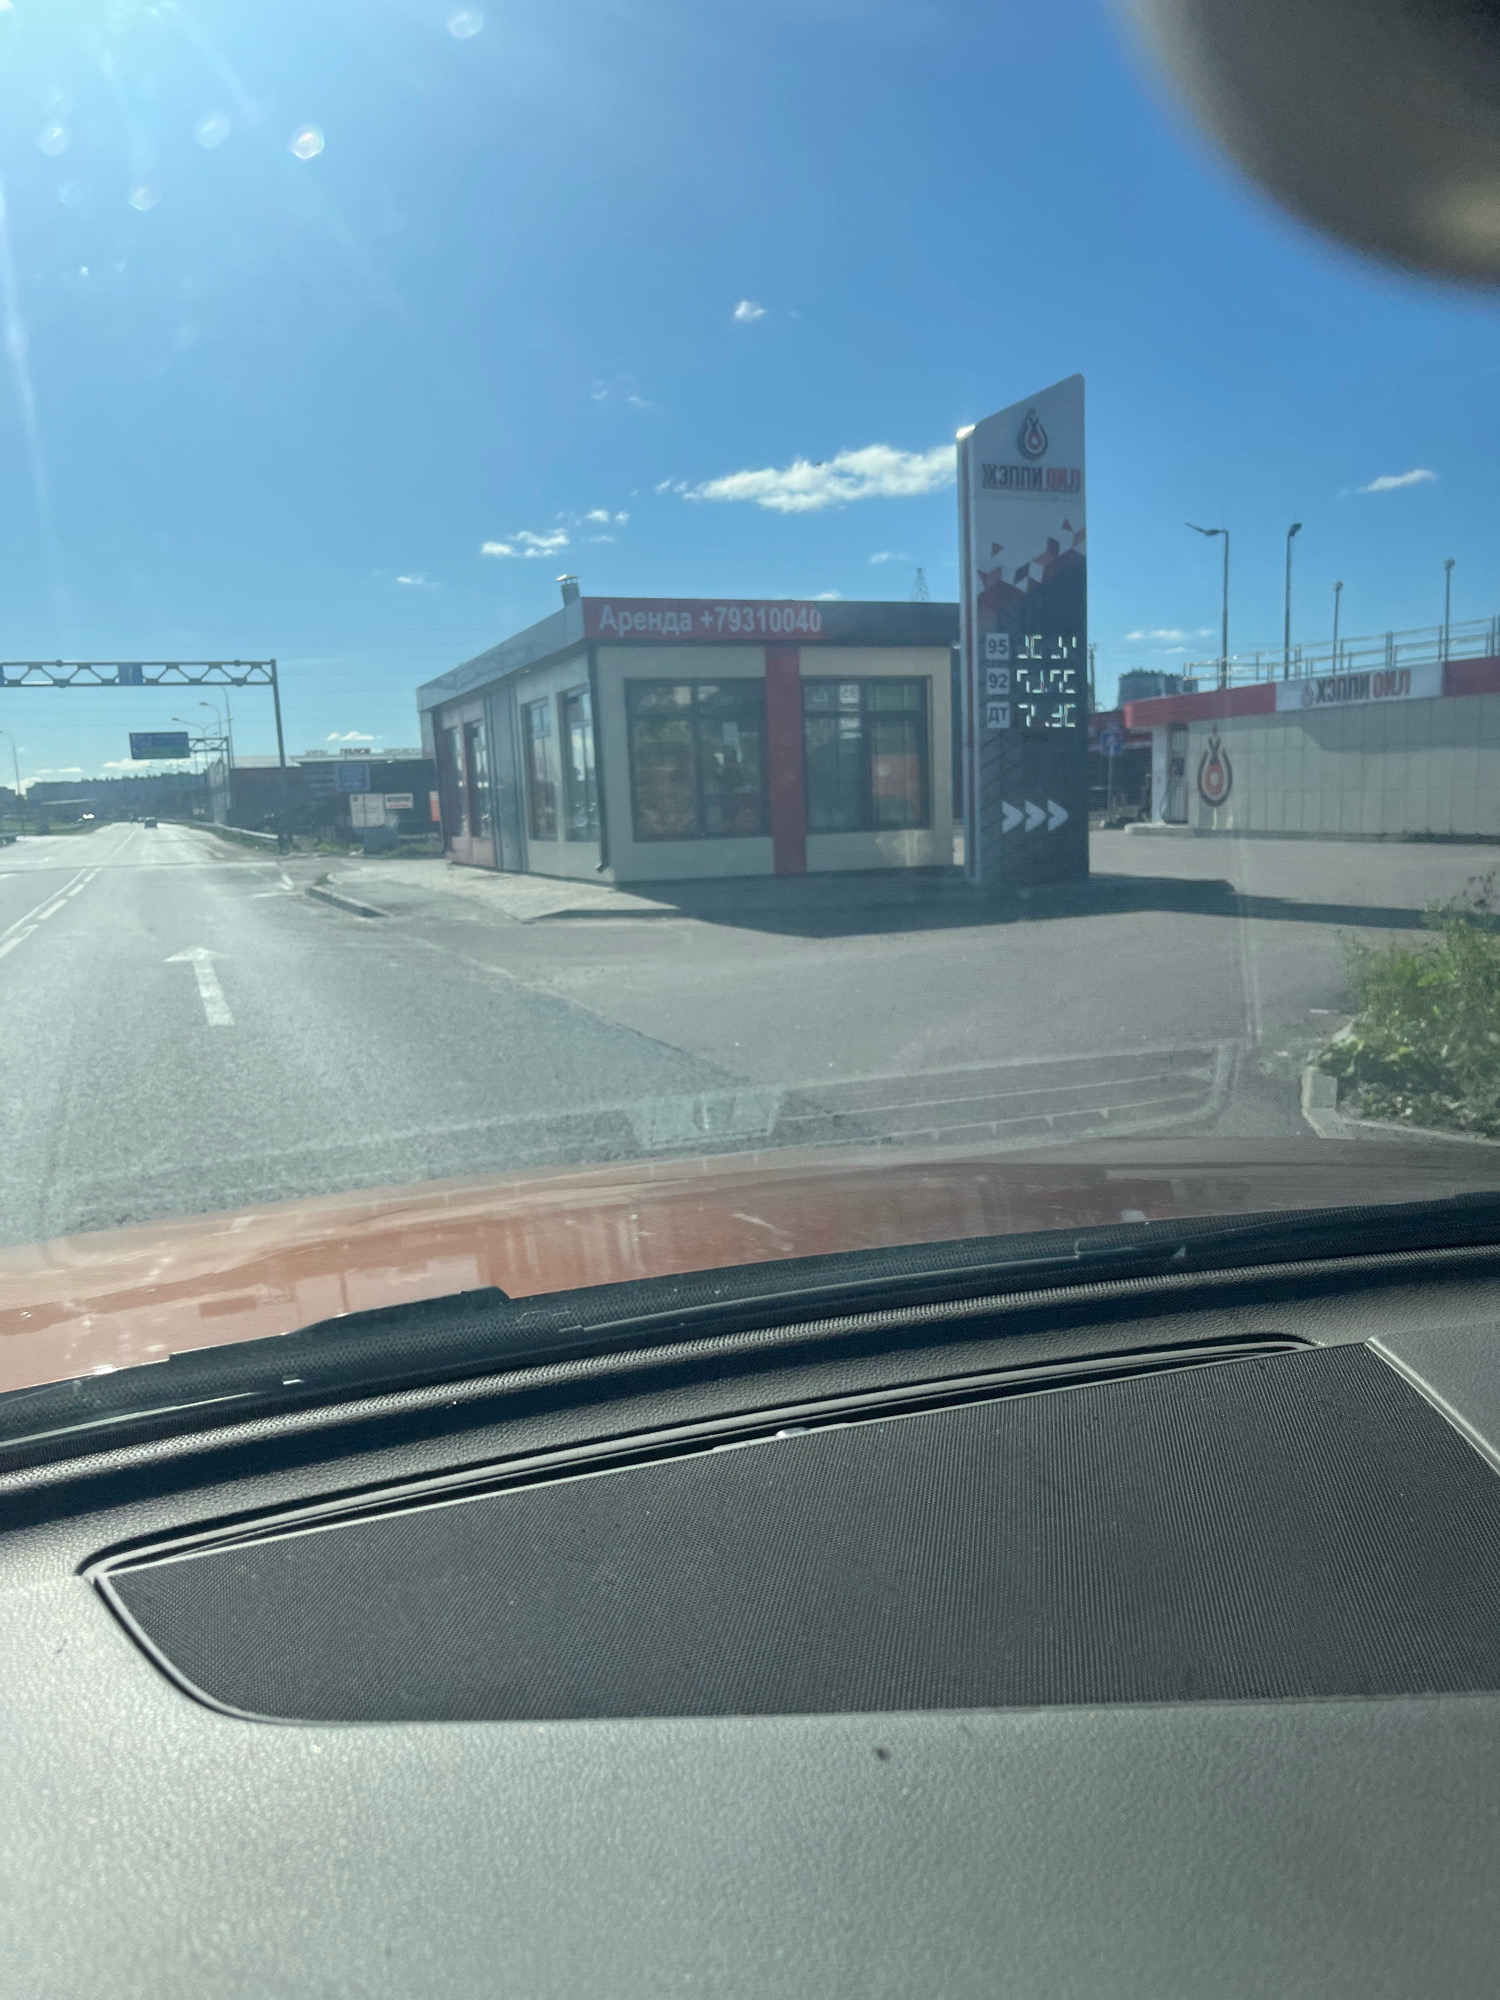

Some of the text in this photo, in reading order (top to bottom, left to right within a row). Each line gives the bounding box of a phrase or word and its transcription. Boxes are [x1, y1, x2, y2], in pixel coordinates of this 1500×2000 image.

[600, 604, 822, 636] Аренда +79310040
[987, 638, 1008, 654] 95
[988, 673, 1009, 689] 92
[988, 707, 1009, 723] ДТ
